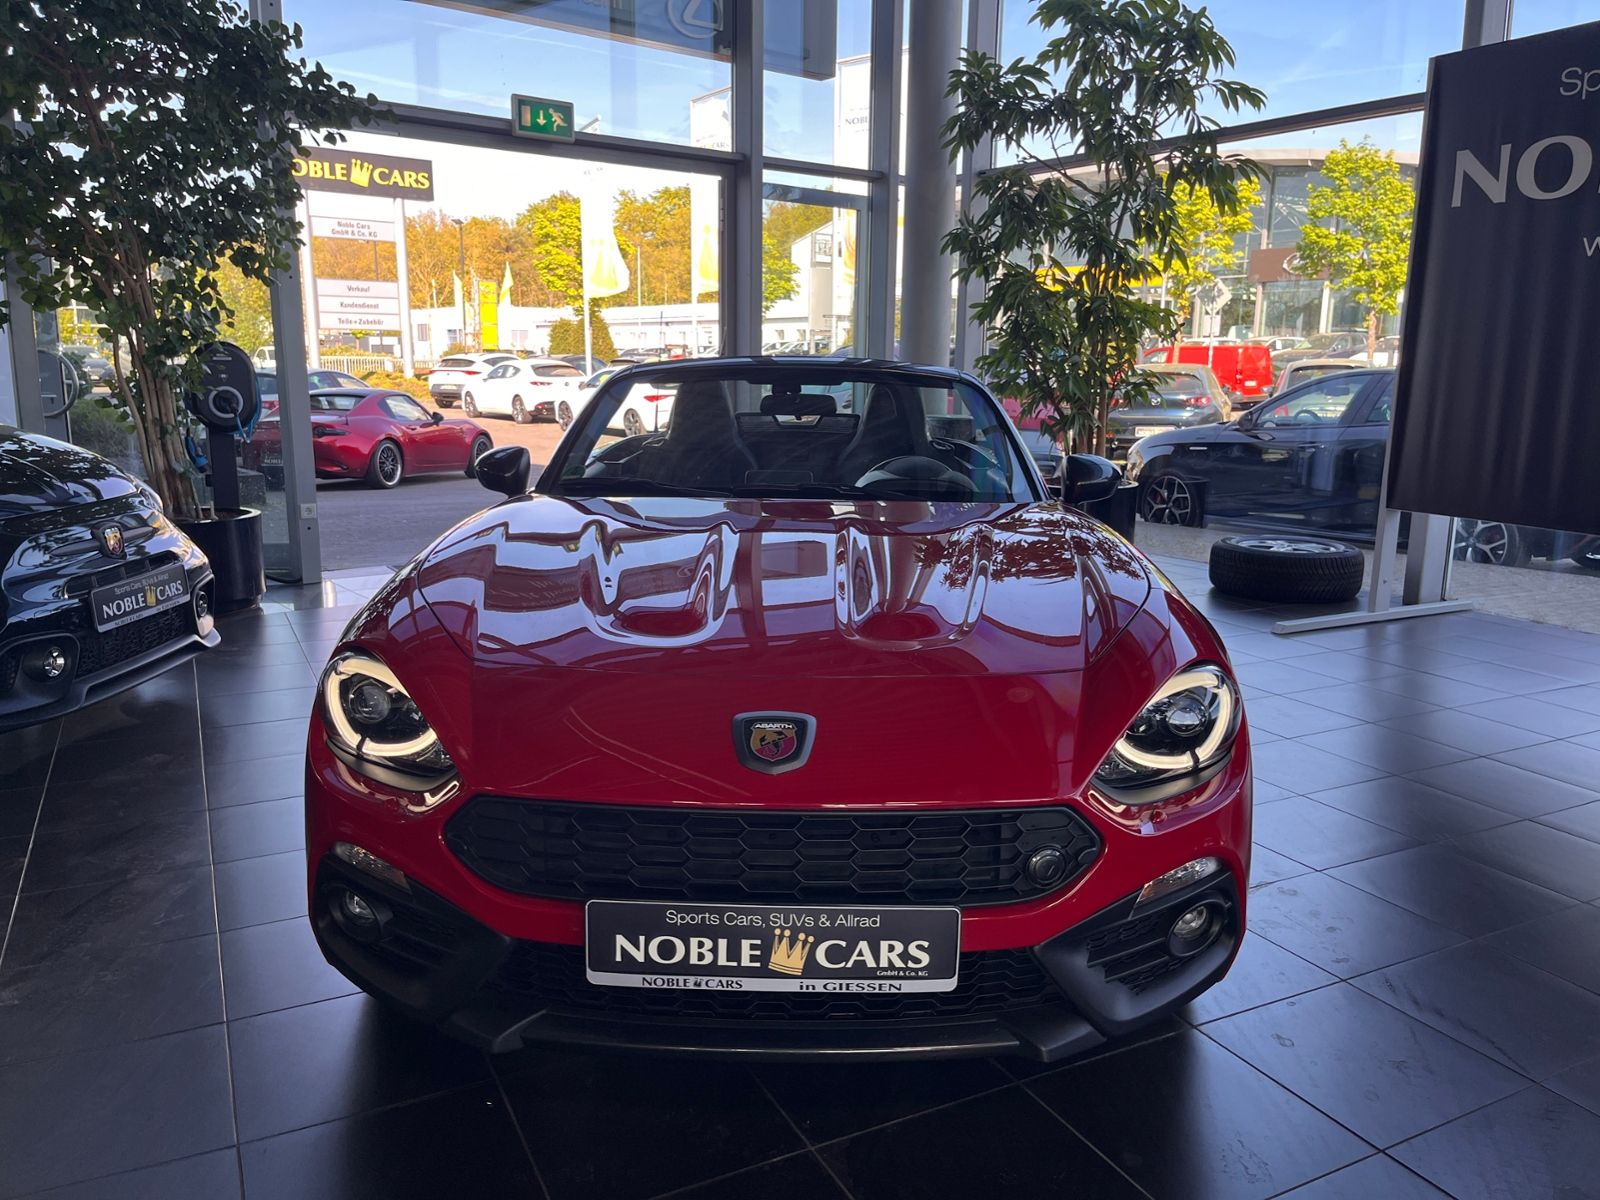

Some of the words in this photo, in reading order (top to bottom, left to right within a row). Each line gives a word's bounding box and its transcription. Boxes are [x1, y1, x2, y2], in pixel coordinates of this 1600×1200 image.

[291, 158, 347, 181] OBLE
[372, 167, 431, 189] CARS
[1451, 135, 1600, 208] NO
[356, 222, 371, 230] Cars
[346, 285, 371, 293] Verkauf
[102, 593, 146, 619] NOBLE
[156, 580, 184, 600] CARS
[665, 909, 720, 926] Sports
[723, 912, 766, 929] Cars,
[769, 912, 815, 928] SUVs
[818, 914, 831, 928] &
[834, 914, 881, 928] Allrad
[615, 934, 762, 968] NOBLE
[815, 939, 931, 969] CARS
[641, 977, 691, 989] NOBLE
[704, 978, 744, 990] CARS
[800, 981, 816, 991] in
[822, 982, 903, 992] GIESSEN
